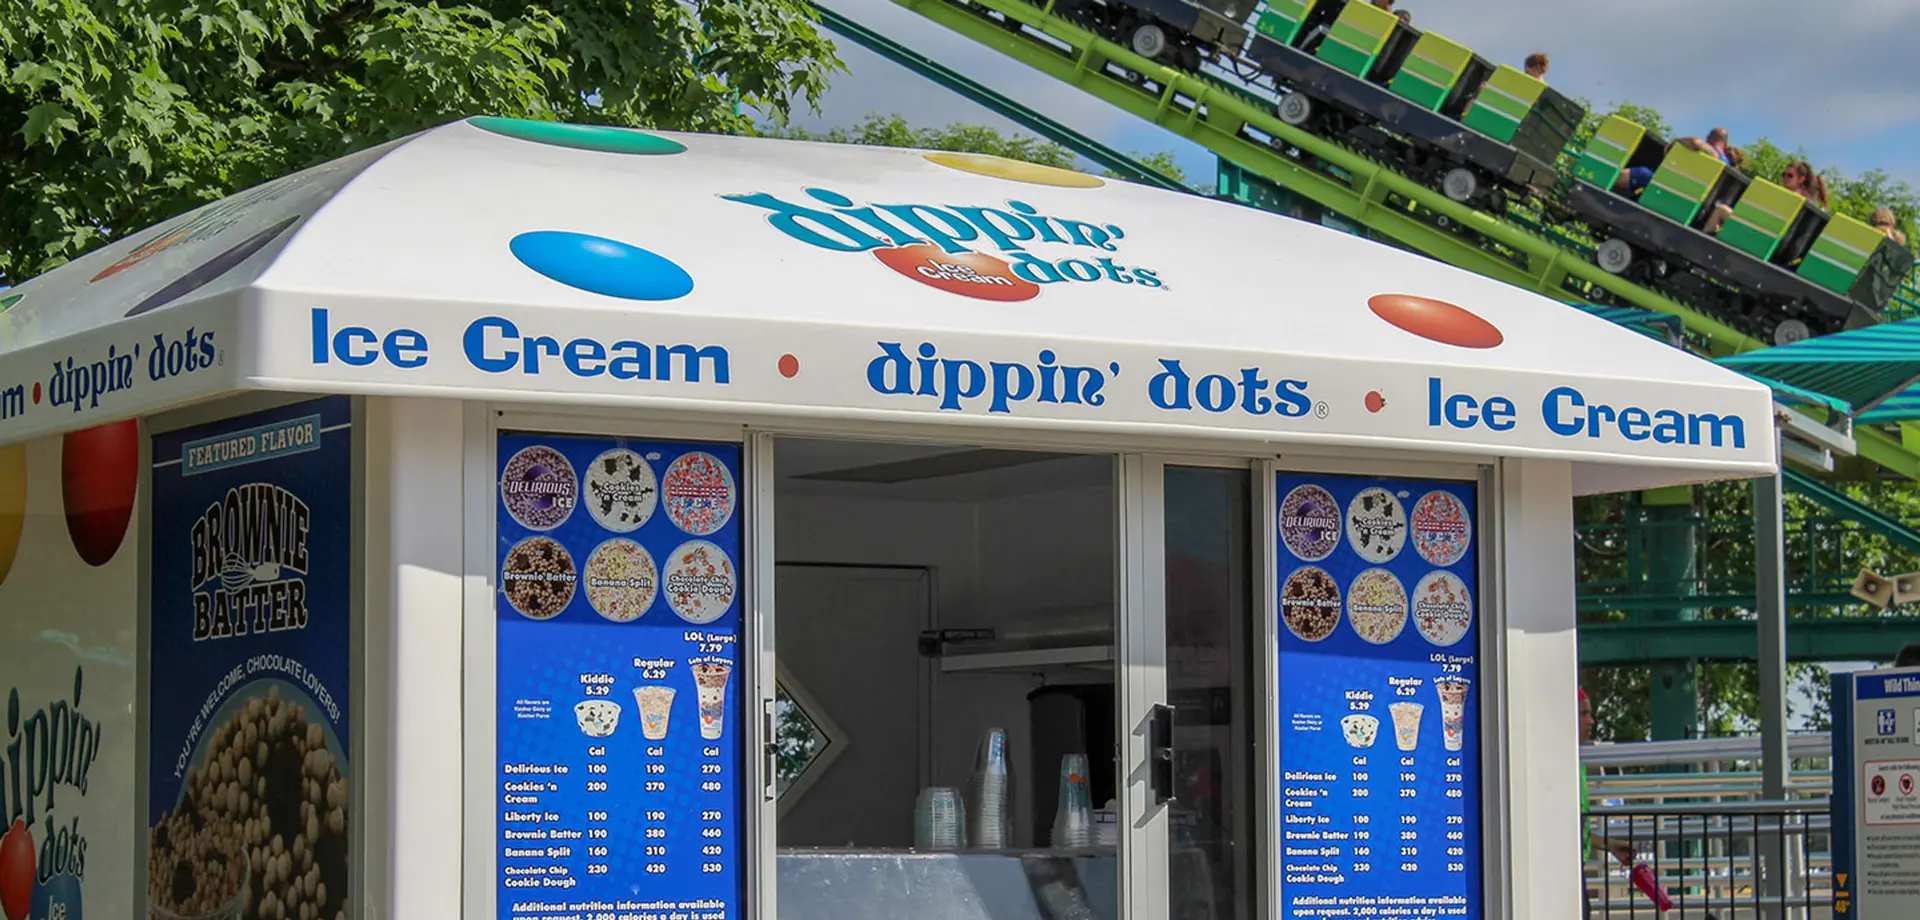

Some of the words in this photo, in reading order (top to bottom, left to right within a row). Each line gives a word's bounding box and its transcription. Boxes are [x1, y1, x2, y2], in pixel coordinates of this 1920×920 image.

[930, 258, 975, 276] Ice
[916, 265, 1015, 286] Cream
[311, 307, 428, 369] Ice
[463, 316, 730, 384] Cream
[50, 343, 140, 412] dippin'
[150, 326, 215, 382] dots
[866, 341, 1120, 413] dippin'
[1428, 377, 1516, 431] Ice
[1542, 386, 1746, 449] Cream
[188, 436, 256, 468] FEATURED
[261, 422, 314, 452] FLAVOR
[509, 480, 572, 494] DELIRIOUS
[552, 498, 573, 508] ICE
[1285, 516, 1336, 529] DELIRIOUS
[191, 483, 310, 591] BROWNIE
[1320, 531, 1337, 541] ICE
[504, 571, 544, 581] Brownie
[546, 573, 577, 582] Batter
[591, 578, 628, 587] Banana
[629, 578, 651, 588] Split
[667, 584, 700, 594] Cookie
[702, 585, 732, 595] Dough
[193, 579, 308, 642] BATTER
[684, 632, 704, 642] LOL
[699, 644, 723, 653] 7.79
[1430, 653, 1448, 662] LOL
[633, 658, 675, 670] Regular
[580, 674, 615, 685] Kiddie
[642, 670, 666, 680] 6.29
[1388, 677, 1423, 687] Regular
[585, 686, 610, 696] 5.29
[1345, 691, 1374, 701] Kiddie
[174, 715, 203, 779] YOU'RE
[200, 663, 247, 720] WELCOME,
[246, 654, 302, 680] CHOCOLATE
[303, 668, 341, 725] LOVERS!
[588, 747, 606, 757] Cal
[647, 747, 664, 757] Cal
[703, 747, 719, 757] Cal
[1353, 757, 1367, 766] Cal
[1400, 757, 1415, 766] Cal
[1446, 758, 1461, 767] Cal
[504, 764, 551, 774] Delirious
[553, 764, 569, 774] Ice
[587, 764, 608, 774] 100
[646, 764, 665, 774] 190
[701, 764, 721, 774] 270
[1285, 772, 1322, 782] Delirious
[1324, 773, 1337, 781] Ice
[1352, 773, 1369, 782] 100
[1400, 773, 1416, 782] 190
[1445, 774, 1462, 782] 270
[504, 782, 545, 792] Cookies
[587, 782, 608, 792] 200
[645, 782, 665, 791] 370
[701, 782, 722, 791] 480
[1285, 788, 1318, 797] Cookies
[1352, 788, 1369, 797] 200
[1400, 789, 1417, 798] 370
[504, 795, 538, 804] Cream
[1285, 799, 1313, 808] Cream
[504, 811, 542, 823] Liberty
[544, 812, 560, 822] Ice
[587, 811, 608, 821] 100
[646, 811, 665, 821] 190
[702, 811, 722, 820] 270
[1286, 815, 1316, 826] Liberty
[1318, 816, 1330, 824] Ice
[1353, 815, 1370, 824] 100
[1401, 815, 1417, 824] 190
[1446, 815, 1463, 824] 270
[504, 829, 547, 839] Brownie
[550, 829, 583, 839] Batter
[588, 829, 608, 839] 190
[645, 829, 666, 838] 380
[702, 829, 722, 838] 460
[1286, 831, 1320, 840] Brownie
[1322, 831, 1349, 840] Batter
[1353, 831, 1370, 840] 190
[504, 847, 545, 857] Banana
[547, 847, 571, 858] Split
[588, 847, 608, 857] 160
[645, 847, 666, 856] 310
[702, 846, 722, 856] 420
[1286, 847, 1318, 856] Banana
[1320, 847, 1340, 858] Split
[1354, 847, 1370, 856] 160
[1401, 847, 1418, 856] 310
[1446, 847, 1464, 856] 420
[505, 866, 547, 875] Chocolate
[549, 866, 569, 877] Chip
[588, 864, 608, 874] 230
[645, 864, 666, 874] 420
[702, 864, 722, 873] 530
[1353, 863, 1370, 872] 230
[1401, 863, 1418, 872] 420
[504, 878, 540, 887] Cookie
[543, 878, 576, 889] Dough
[1286, 874, 1315, 883] Cookie
[1317, 874, 1345, 885] Dough
[1293, 896, 1337, 905] Additional
[1339, 896, 1376, 905] nutrition
[1377, 896, 1426, 905] information
[1428, 896, 1467, 905] available
[512, 902, 567, 912] Additional
[569, 901, 614, 911] nutrition
[616, 900, 676, 911] information
[678, 900, 725, 910] available
[1293, 907, 1315, 917] upon
[1316, 907, 1350, 917] request.
[1353, 907, 1377, 916] 2,000
[1378, 907, 1411, 916] calories
[1420, 907, 1437, 917] day
[1438, 906, 1446, 915] is
[1447, 906, 1467, 915] used
